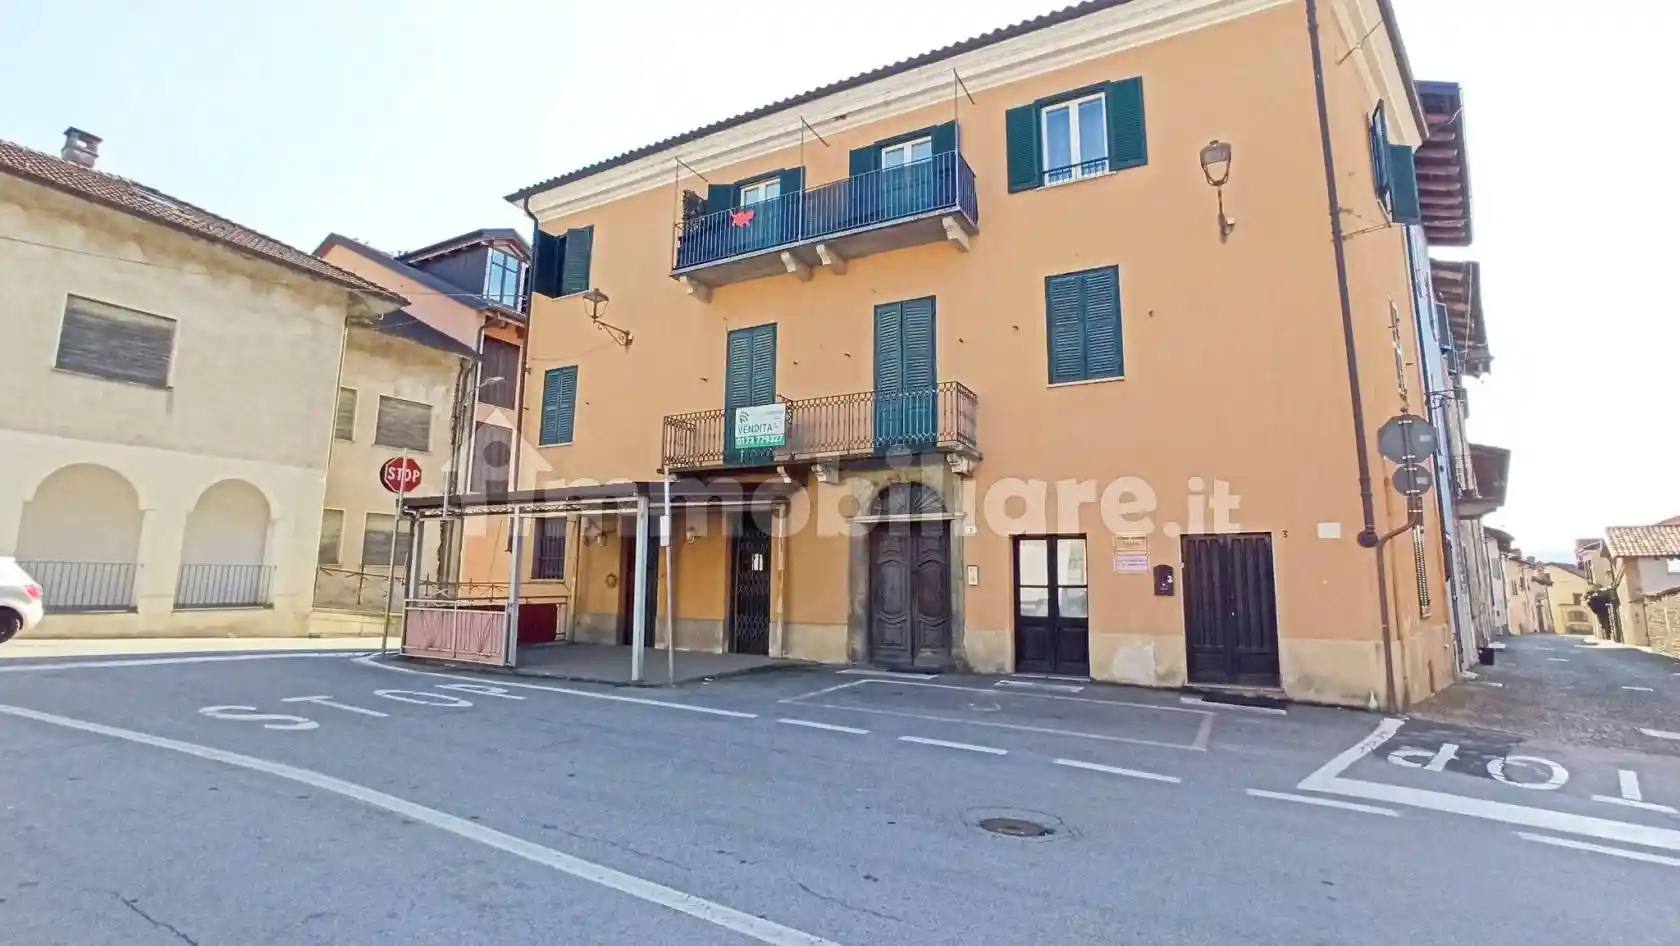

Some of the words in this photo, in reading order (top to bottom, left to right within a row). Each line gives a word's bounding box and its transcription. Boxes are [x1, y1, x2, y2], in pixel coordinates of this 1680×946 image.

[738, 424, 773, 434] VENDITA
[387, 466, 420, 482] STOP
[198, 684, 527, 730] STOP
